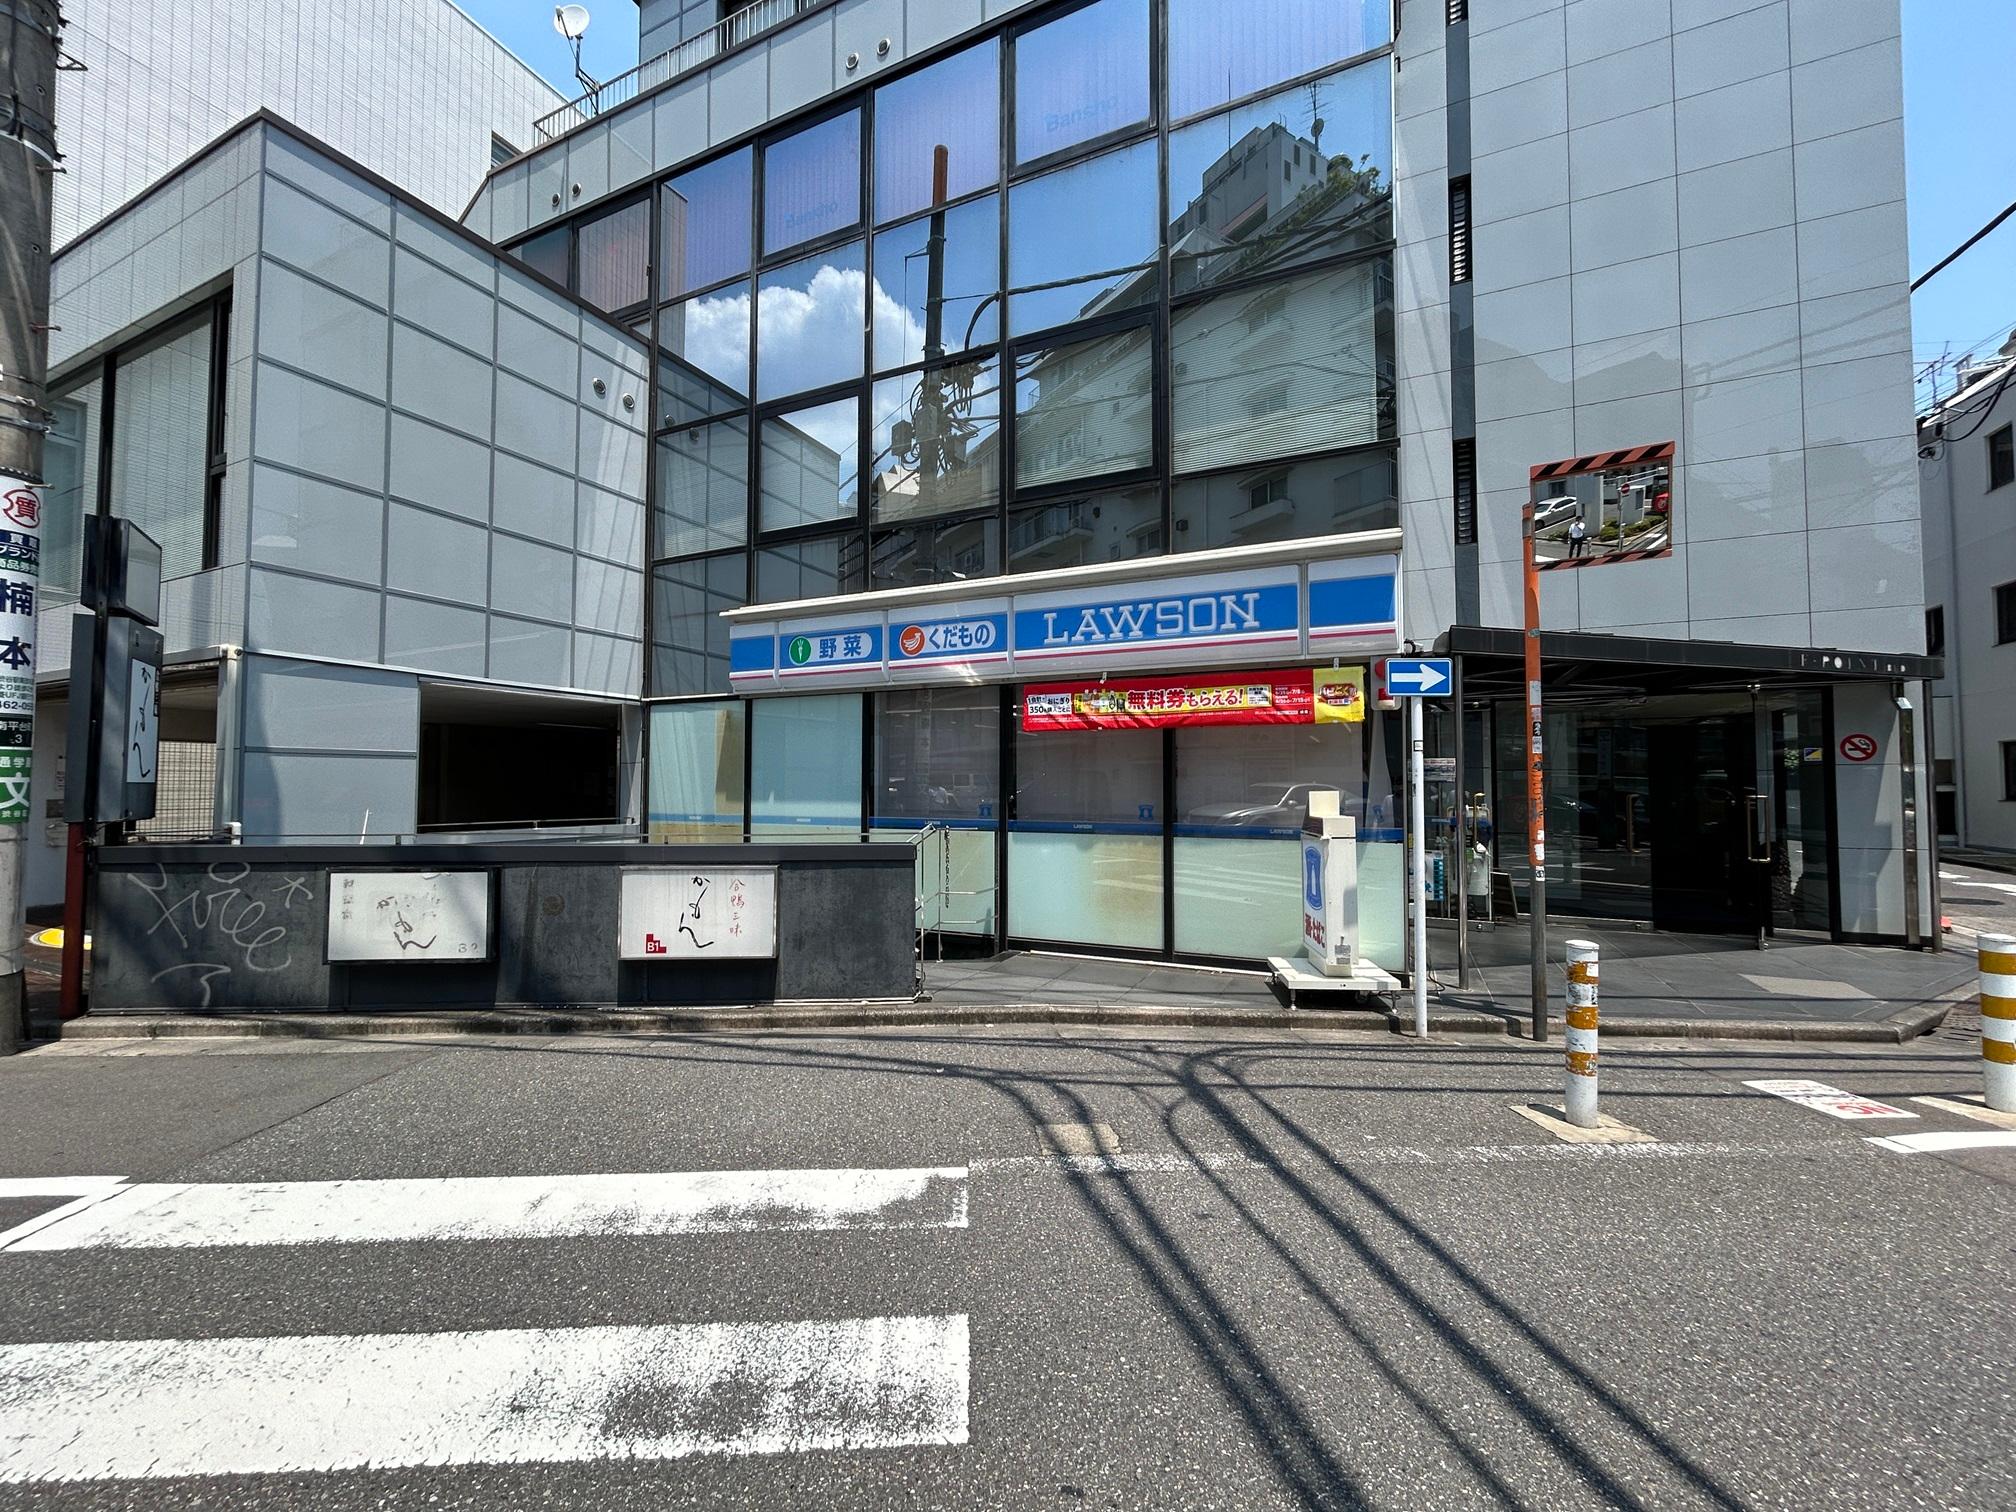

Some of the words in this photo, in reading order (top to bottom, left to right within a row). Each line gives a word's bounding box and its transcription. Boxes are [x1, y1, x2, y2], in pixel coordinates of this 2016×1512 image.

[15, 496, 37, 522] 質
[1044, 592, 1260, 645] LAWSON
[818, 635, 862, 659] 野菜
[928, 624, 990, 650] くだもの
[1127, 688, 1243, 710] 無料券もらえる!
[647, 941, 660, 952] B1
